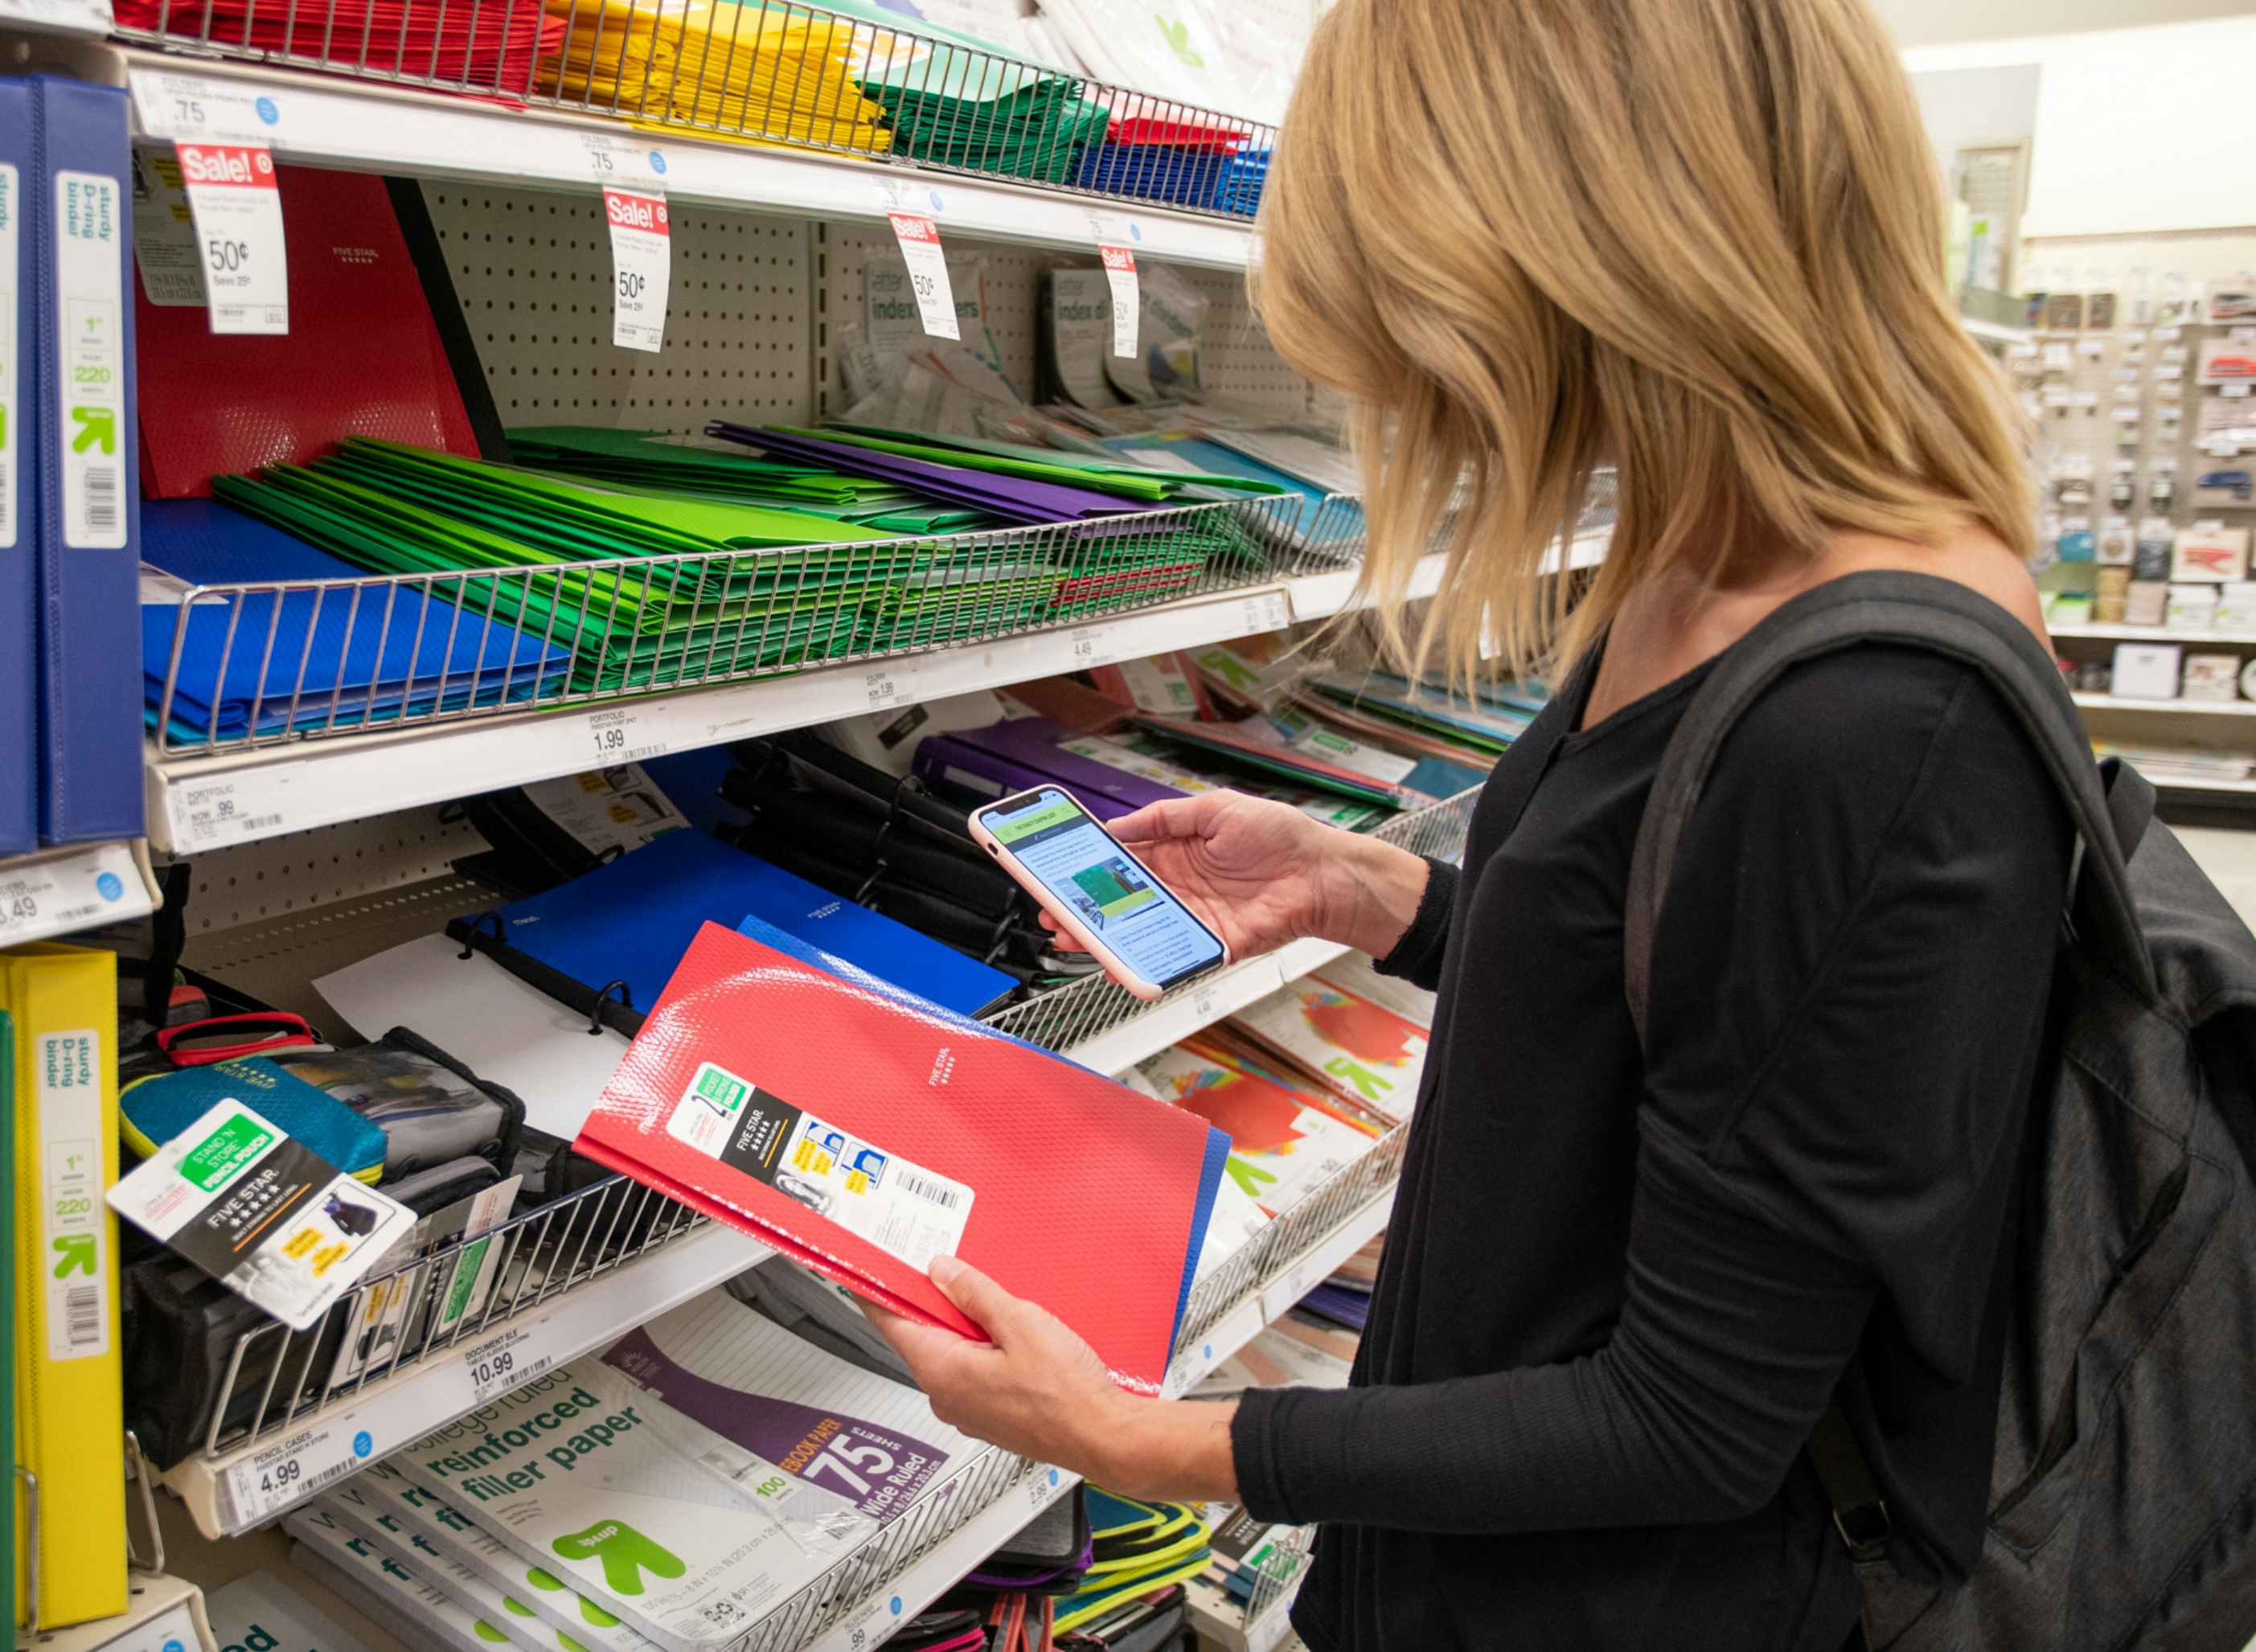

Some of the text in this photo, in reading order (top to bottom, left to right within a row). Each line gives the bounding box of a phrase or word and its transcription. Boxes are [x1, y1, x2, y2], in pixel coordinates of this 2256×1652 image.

[174, 100, 205, 122] .75
[183, 148, 253, 182] Sale!
[592, 151, 613, 170] .75
[68, 181, 80, 239] binder
[82, 183, 97, 239] D-ring
[99, 187, 113, 242] sturdy
[609, 195, 654, 229] Sale!
[890, 216, 928, 240] Sale!
[210, 240, 249, 273] 50¢
[332, 247, 355, 256] FIVE
[1101, 249, 1128, 269] Sale!
[619, 271, 646, 298] 50¢
[75, 366, 111, 384] 220
[589, 711, 625, 724] PORTFOLIO
[594, 729, 624, 751] 1.99
[47, 1039, 60, 1089] binder
[61, 1039, 76, 1088] D-ring
[77, 1037, 93, 1086] sturdy
[691, 1095, 728, 1118] 2
[736, 1109, 765, 1152] FIVE STAR
[192, 1136, 226, 1164] STAND
[202, 1133, 271, 1190] PENCIL POUCH
[56, 1197, 92, 1216] 220
[207, 1168, 280, 1229] FIVE STAR
[465, 1335, 504, 1360] DOCUMENT
[505, 1328, 519, 1341] SLE
[471, 1351, 513, 1386] 10.99
[254, 1429, 313, 1465] PENCIL CASES
[425, 1386, 601, 1478] reinforced
[779, 1440, 822, 1474] EBOOK
[807, 1418, 843, 1444] PAPER
[850, 1426, 902, 1451] SHEETS
[461, 1460, 547, 1502] filler
[545, 1406, 643, 1471] paper
[803, 1433, 894, 1496] 75
[260, 1459, 301, 1494] 4.99
[756, 1475, 787, 1499] 100
[859, 1452, 929, 1518] Wide Ruled
